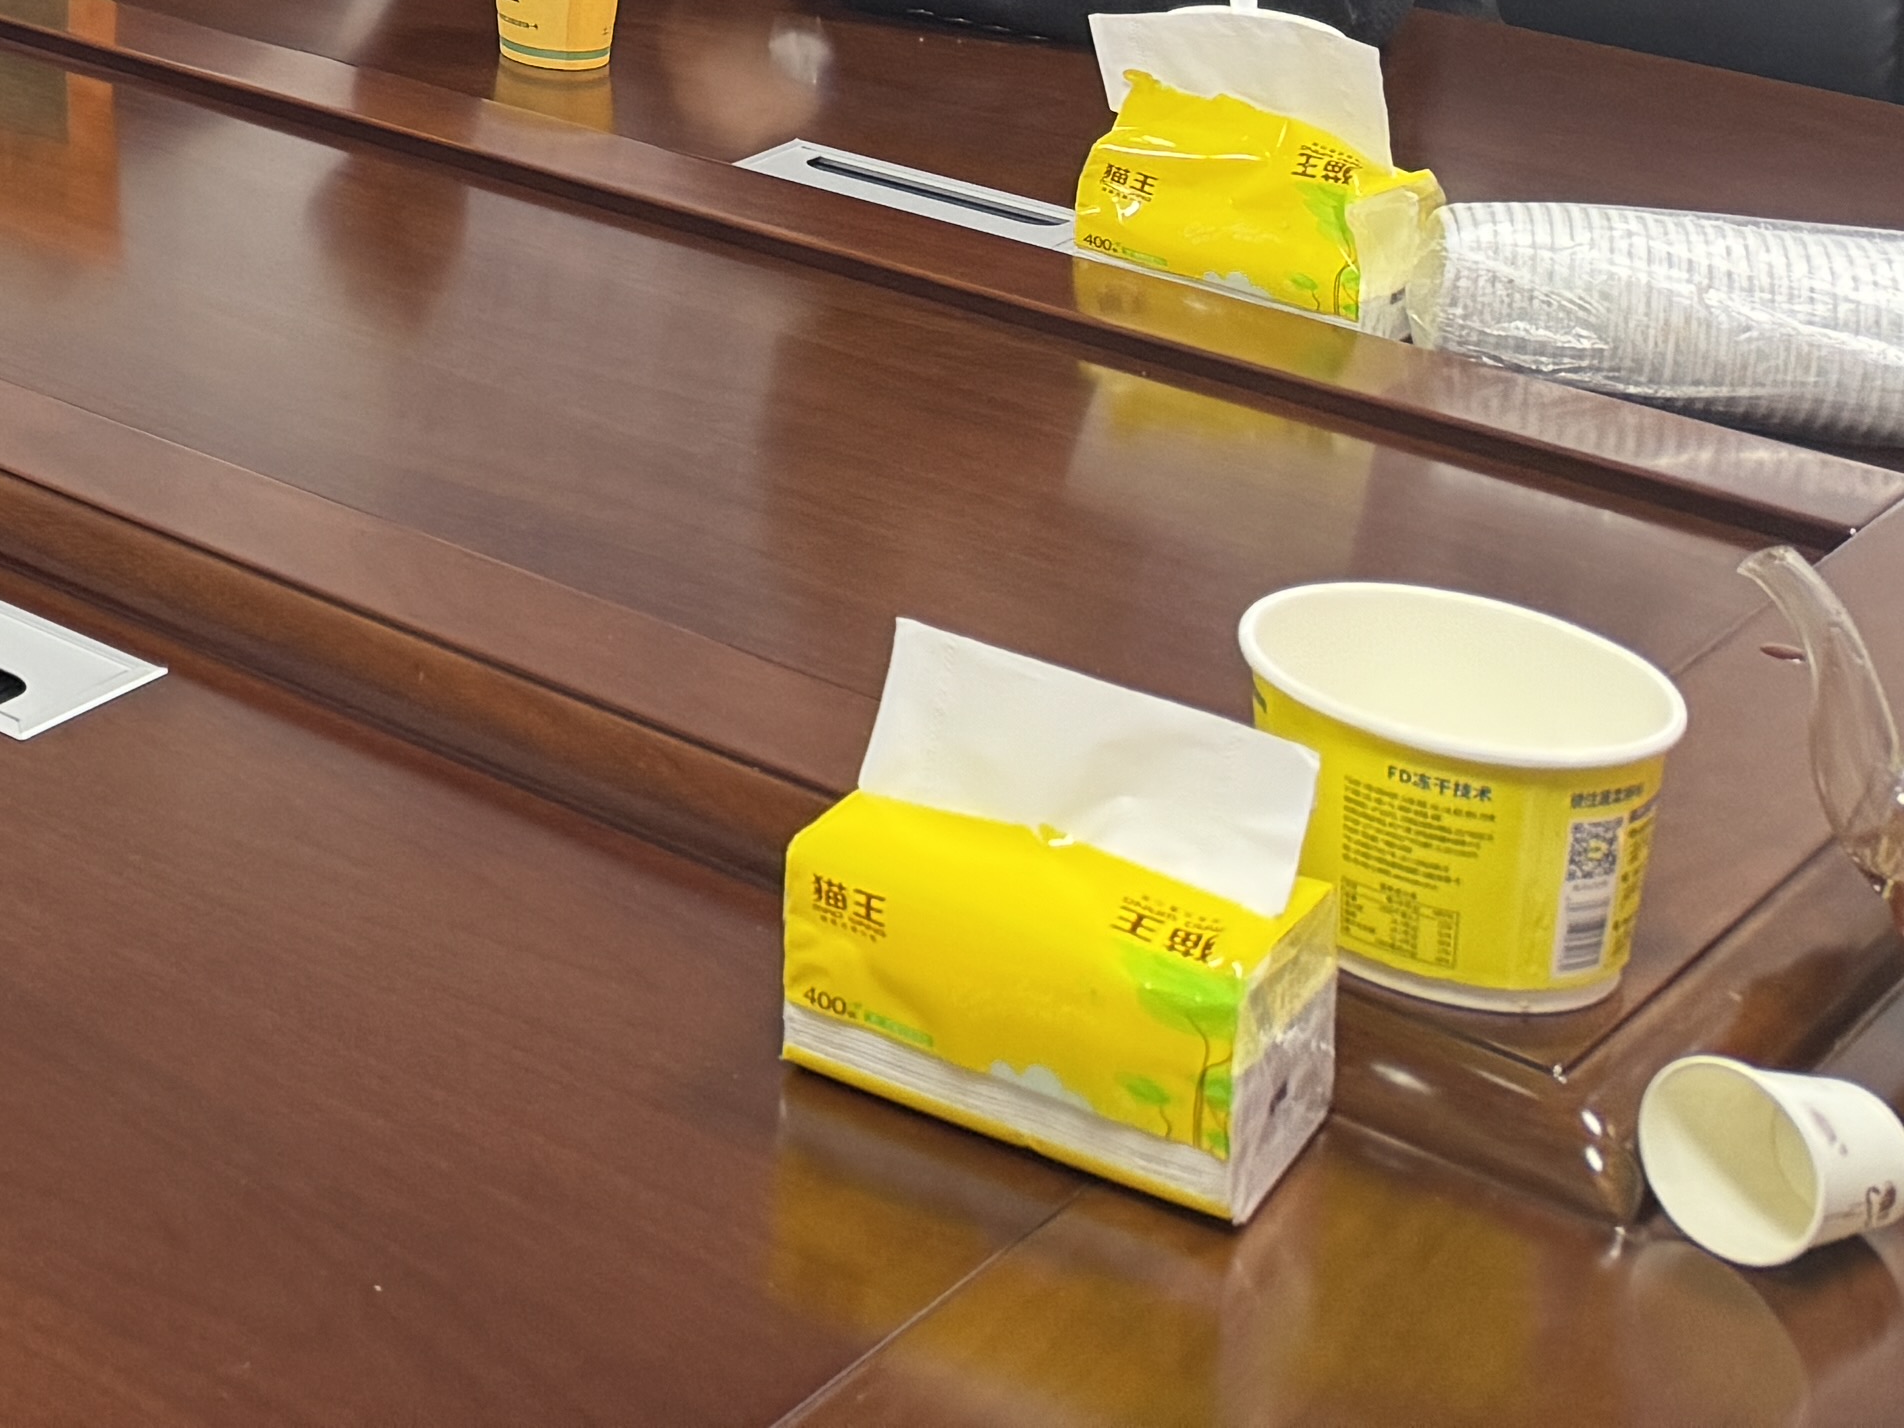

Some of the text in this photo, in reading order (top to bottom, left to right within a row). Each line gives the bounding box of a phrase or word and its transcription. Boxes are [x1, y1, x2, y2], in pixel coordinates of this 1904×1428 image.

[1101, 163, 1159, 196] 猫王
[1290, 152, 1363, 186] 猫王
[812, 873, 887, 928] 猫王
[1109, 905, 1219, 964] 猫王
